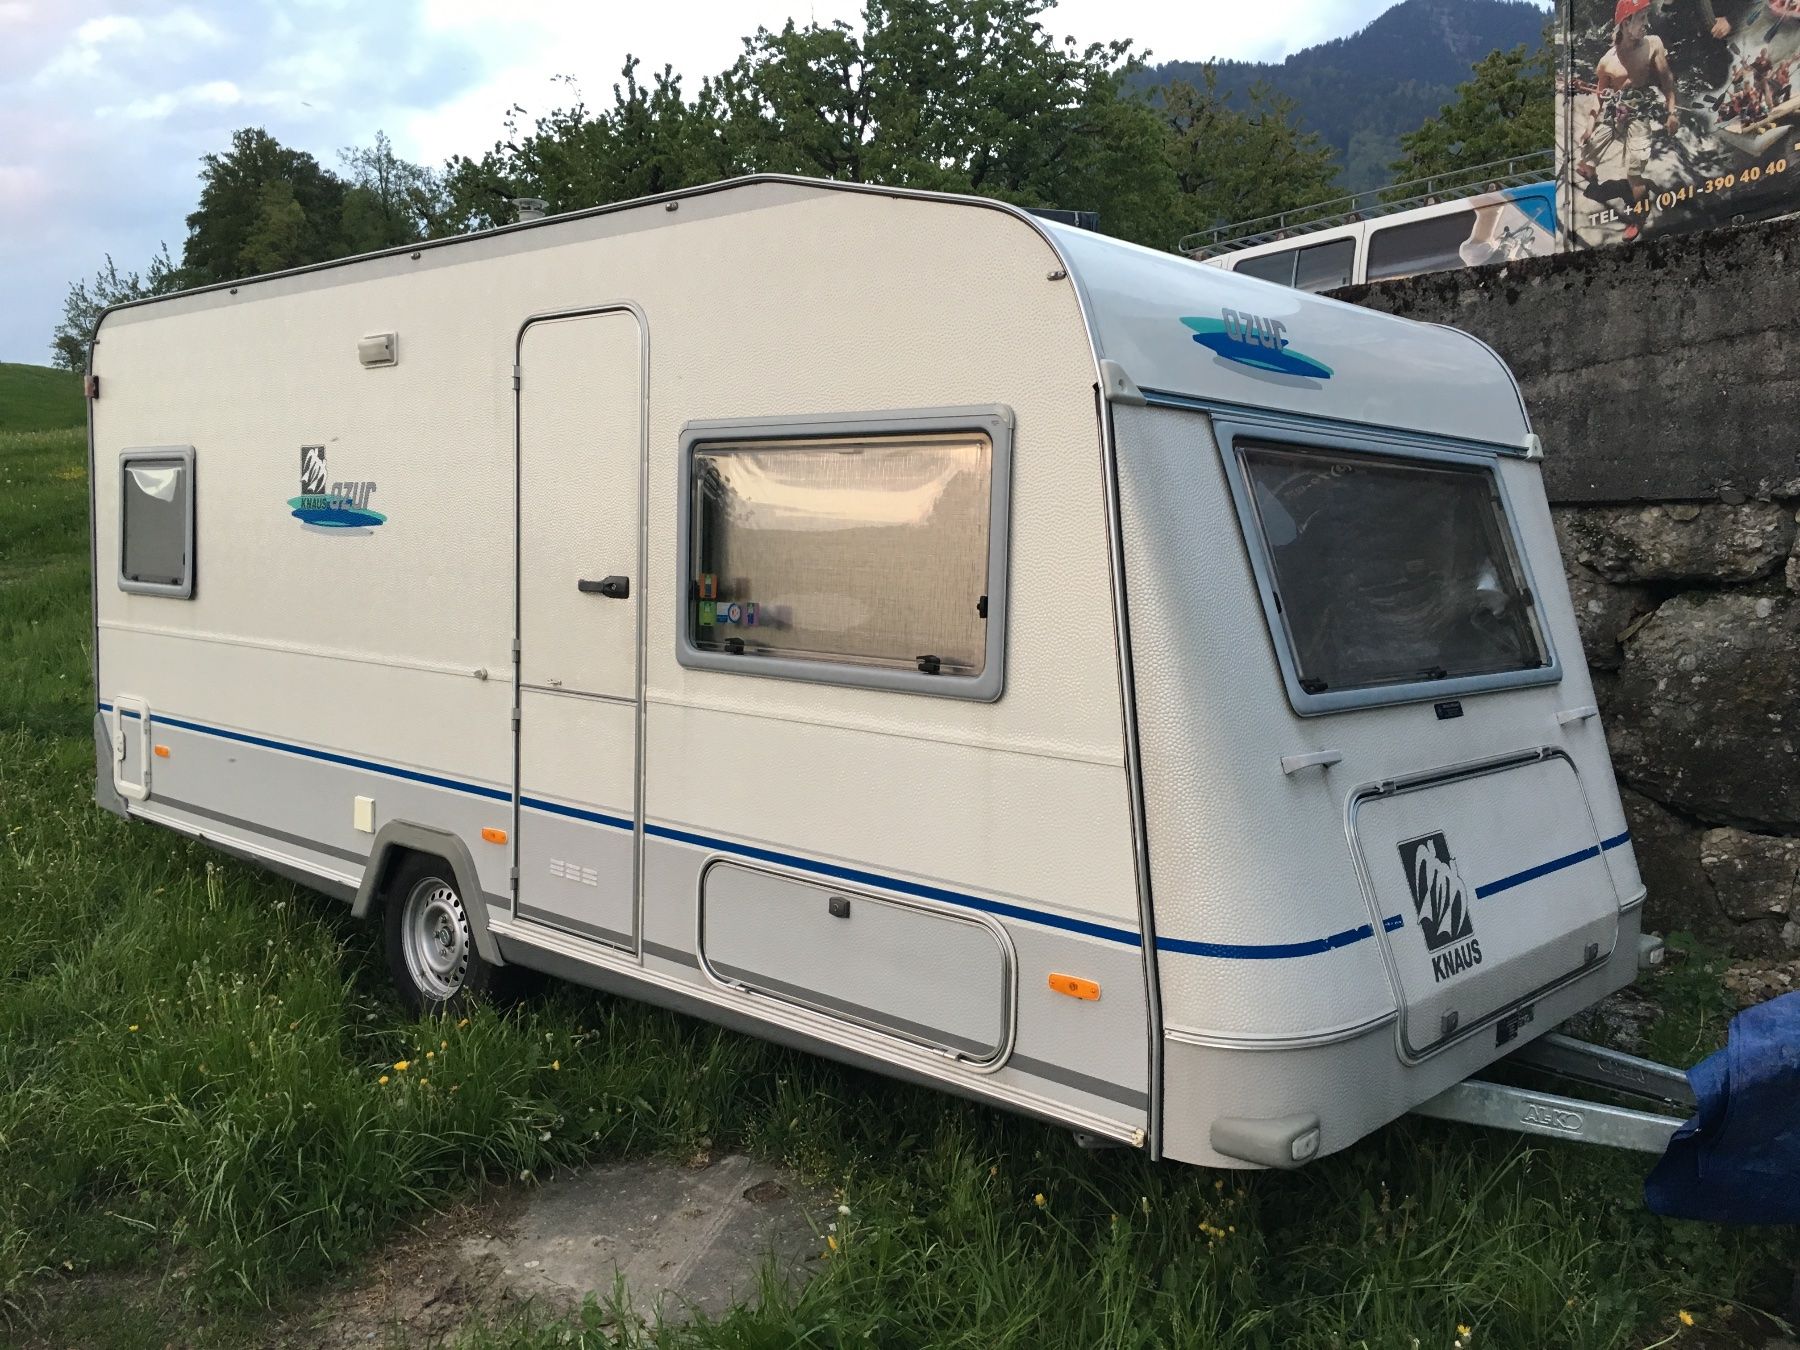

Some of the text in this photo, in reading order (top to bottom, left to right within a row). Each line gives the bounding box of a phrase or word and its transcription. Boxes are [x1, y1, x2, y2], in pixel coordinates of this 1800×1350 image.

[1588, 208, 1619, 226] TEL
[1623, 197, 1651, 216] +41
[1739, 166, 1761, 184] 40
[1765, 159, 1787, 176] 40
[301, 497, 327, 510] KNAUS
[1431, 938, 1482, 983] KNAUS
